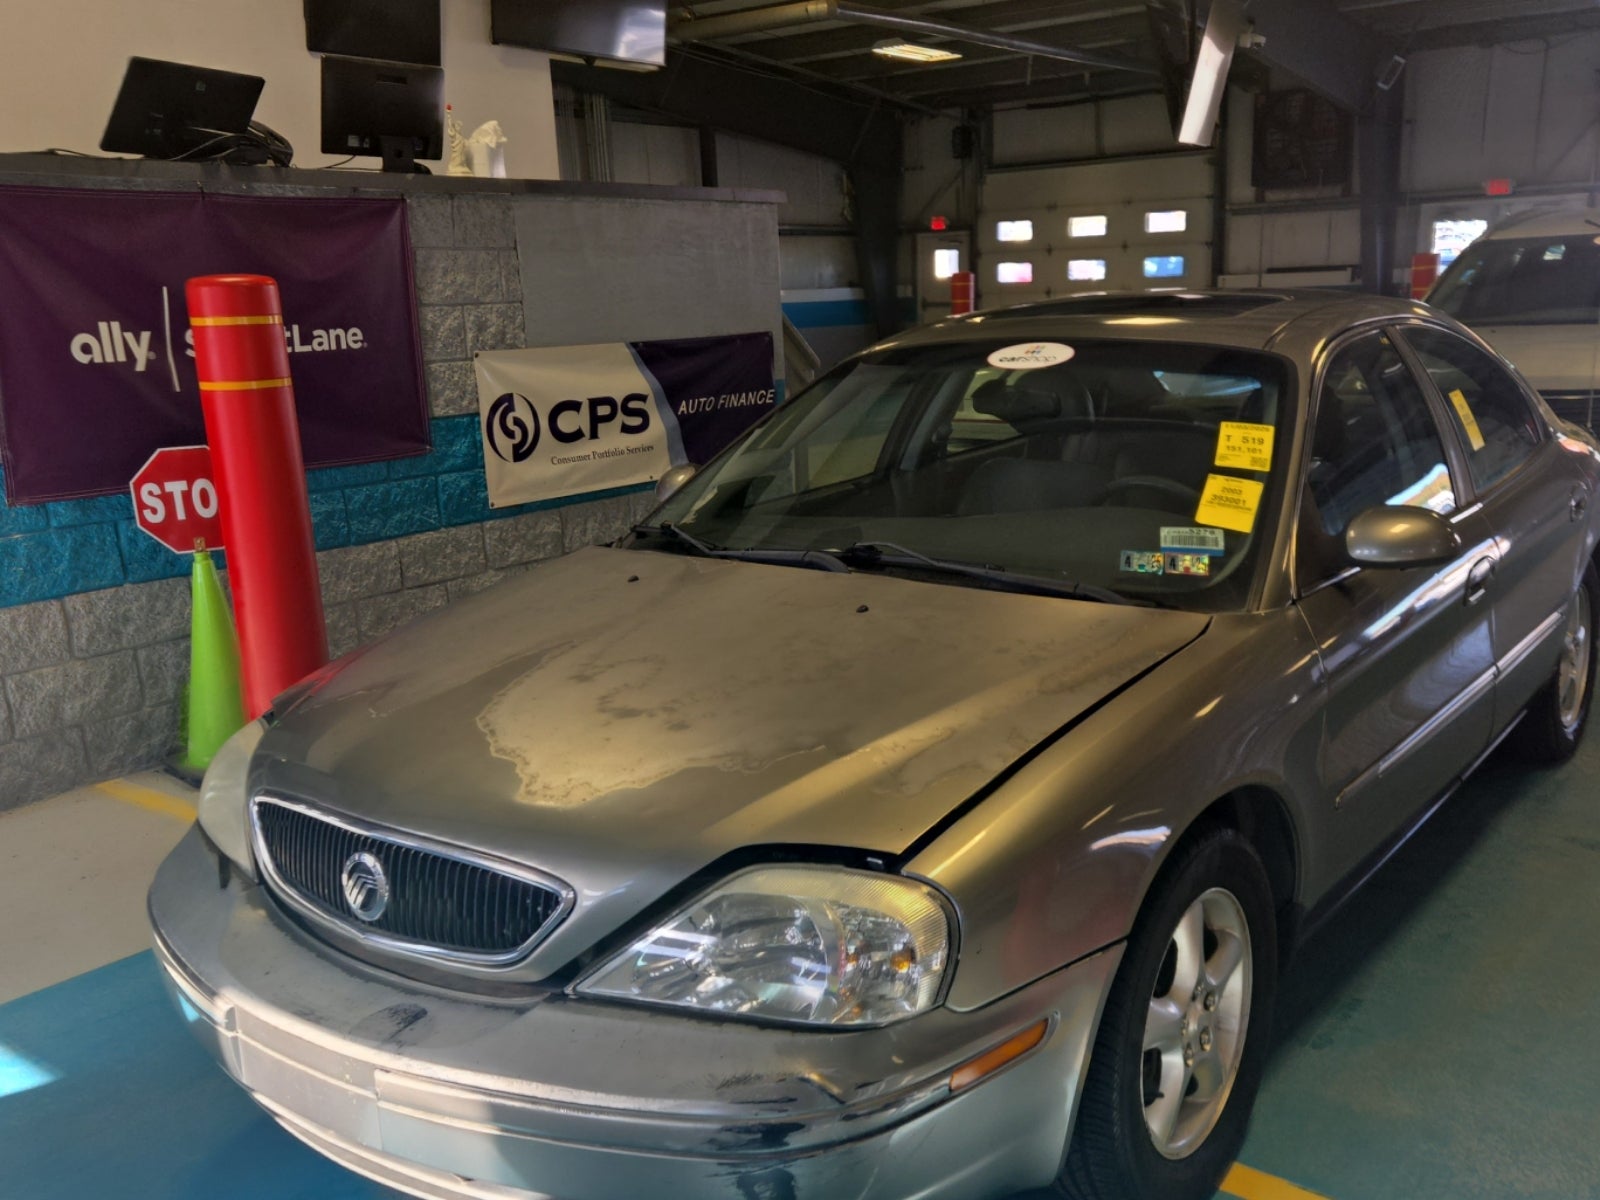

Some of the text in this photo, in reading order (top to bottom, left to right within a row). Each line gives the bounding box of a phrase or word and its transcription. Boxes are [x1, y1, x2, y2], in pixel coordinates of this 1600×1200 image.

[70, 320, 151, 372] ally
[548, 392, 650, 444] CPS
[678, 389, 775, 415] AUTO FINANCE
[551, 443, 655, 466] Consumer Portfolio Services
[140, 478, 219, 524] STO
